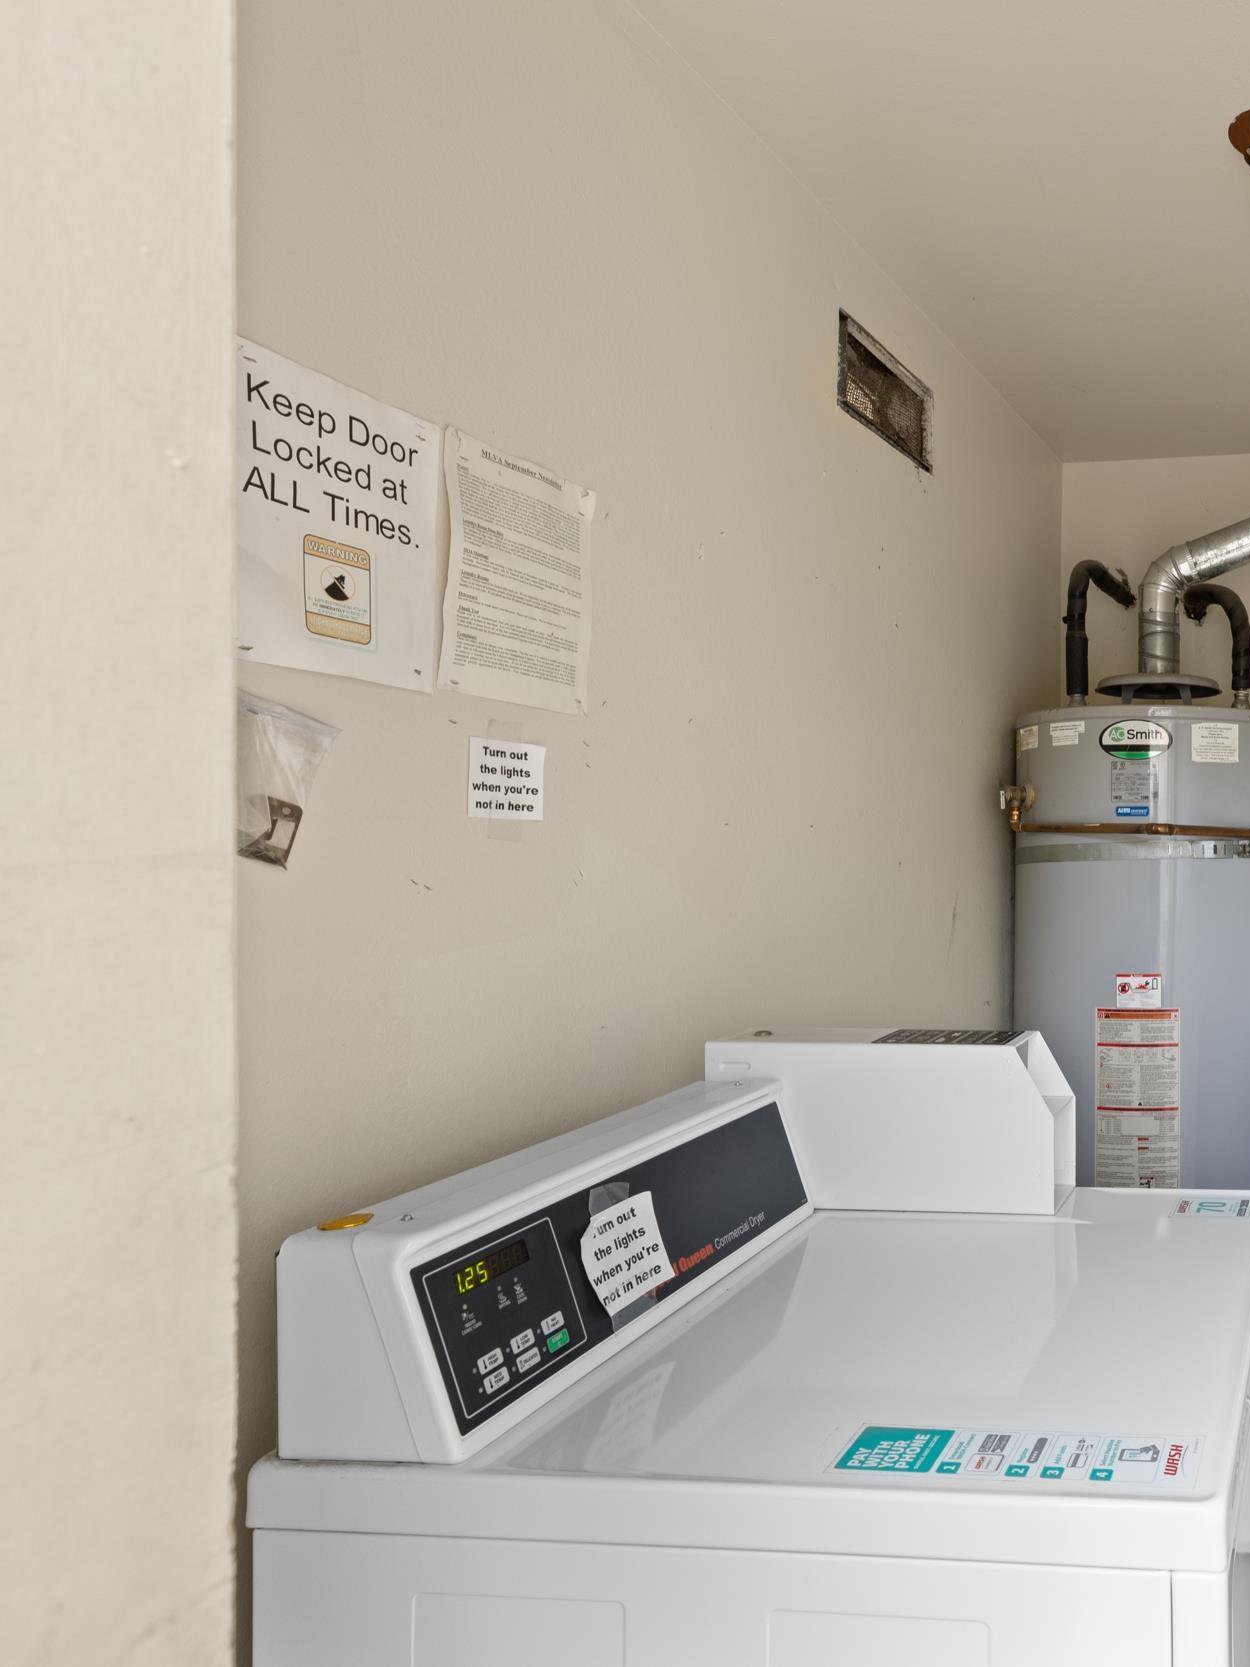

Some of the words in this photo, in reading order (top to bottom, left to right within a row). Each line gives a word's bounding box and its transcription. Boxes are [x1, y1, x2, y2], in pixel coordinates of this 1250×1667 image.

[247, 372, 336, 438] Keep
[349, 415, 418, 467] Door
[252, 420, 371, 491] Locked
[382, 479, 407, 505] at
[242, 466, 310, 513] ALL
[323, 491, 419, 548] Times.
[307, 539, 368, 564] WARNING
[1127, 729, 1162, 740] Smith
[483, 746, 506, 758] Turn
[510, 752, 528, 760] out
[480, 764, 497, 774] the
[501, 766, 530, 778] lights
[472, 781, 501, 792] when
[504, 785, 538, 795] you're
[475, 800, 492, 809] not
[495, 800, 504, 810] in
[508, 801, 534, 812] here
[593, 1221, 615, 1238] urn
[617, 1206, 637, 1224] out
[594, 1245, 612, 1261] the
[614, 1227, 646, 1251] lights
[679, 1243, 714, 1271] Queen
[714, 1220, 749, 1249] Commercial
[750, 1212, 766, 1231] Dryer
[593, 1263, 622, 1286] when
[626, 1242, 659, 1271] you're
[603, 1287, 620, 1306] not
[622, 1279, 633, 1294] in
[635, 1263, 661, 1285] here
[846, 1448, 871, 1466] PAY
[863, 1441, 894, 1467] WITH
[878, 1440, 910, 1468] YOUR
[894, 1434, 931, 1468] PHONE
[1164, 1444, 1183, 1476] WASH
